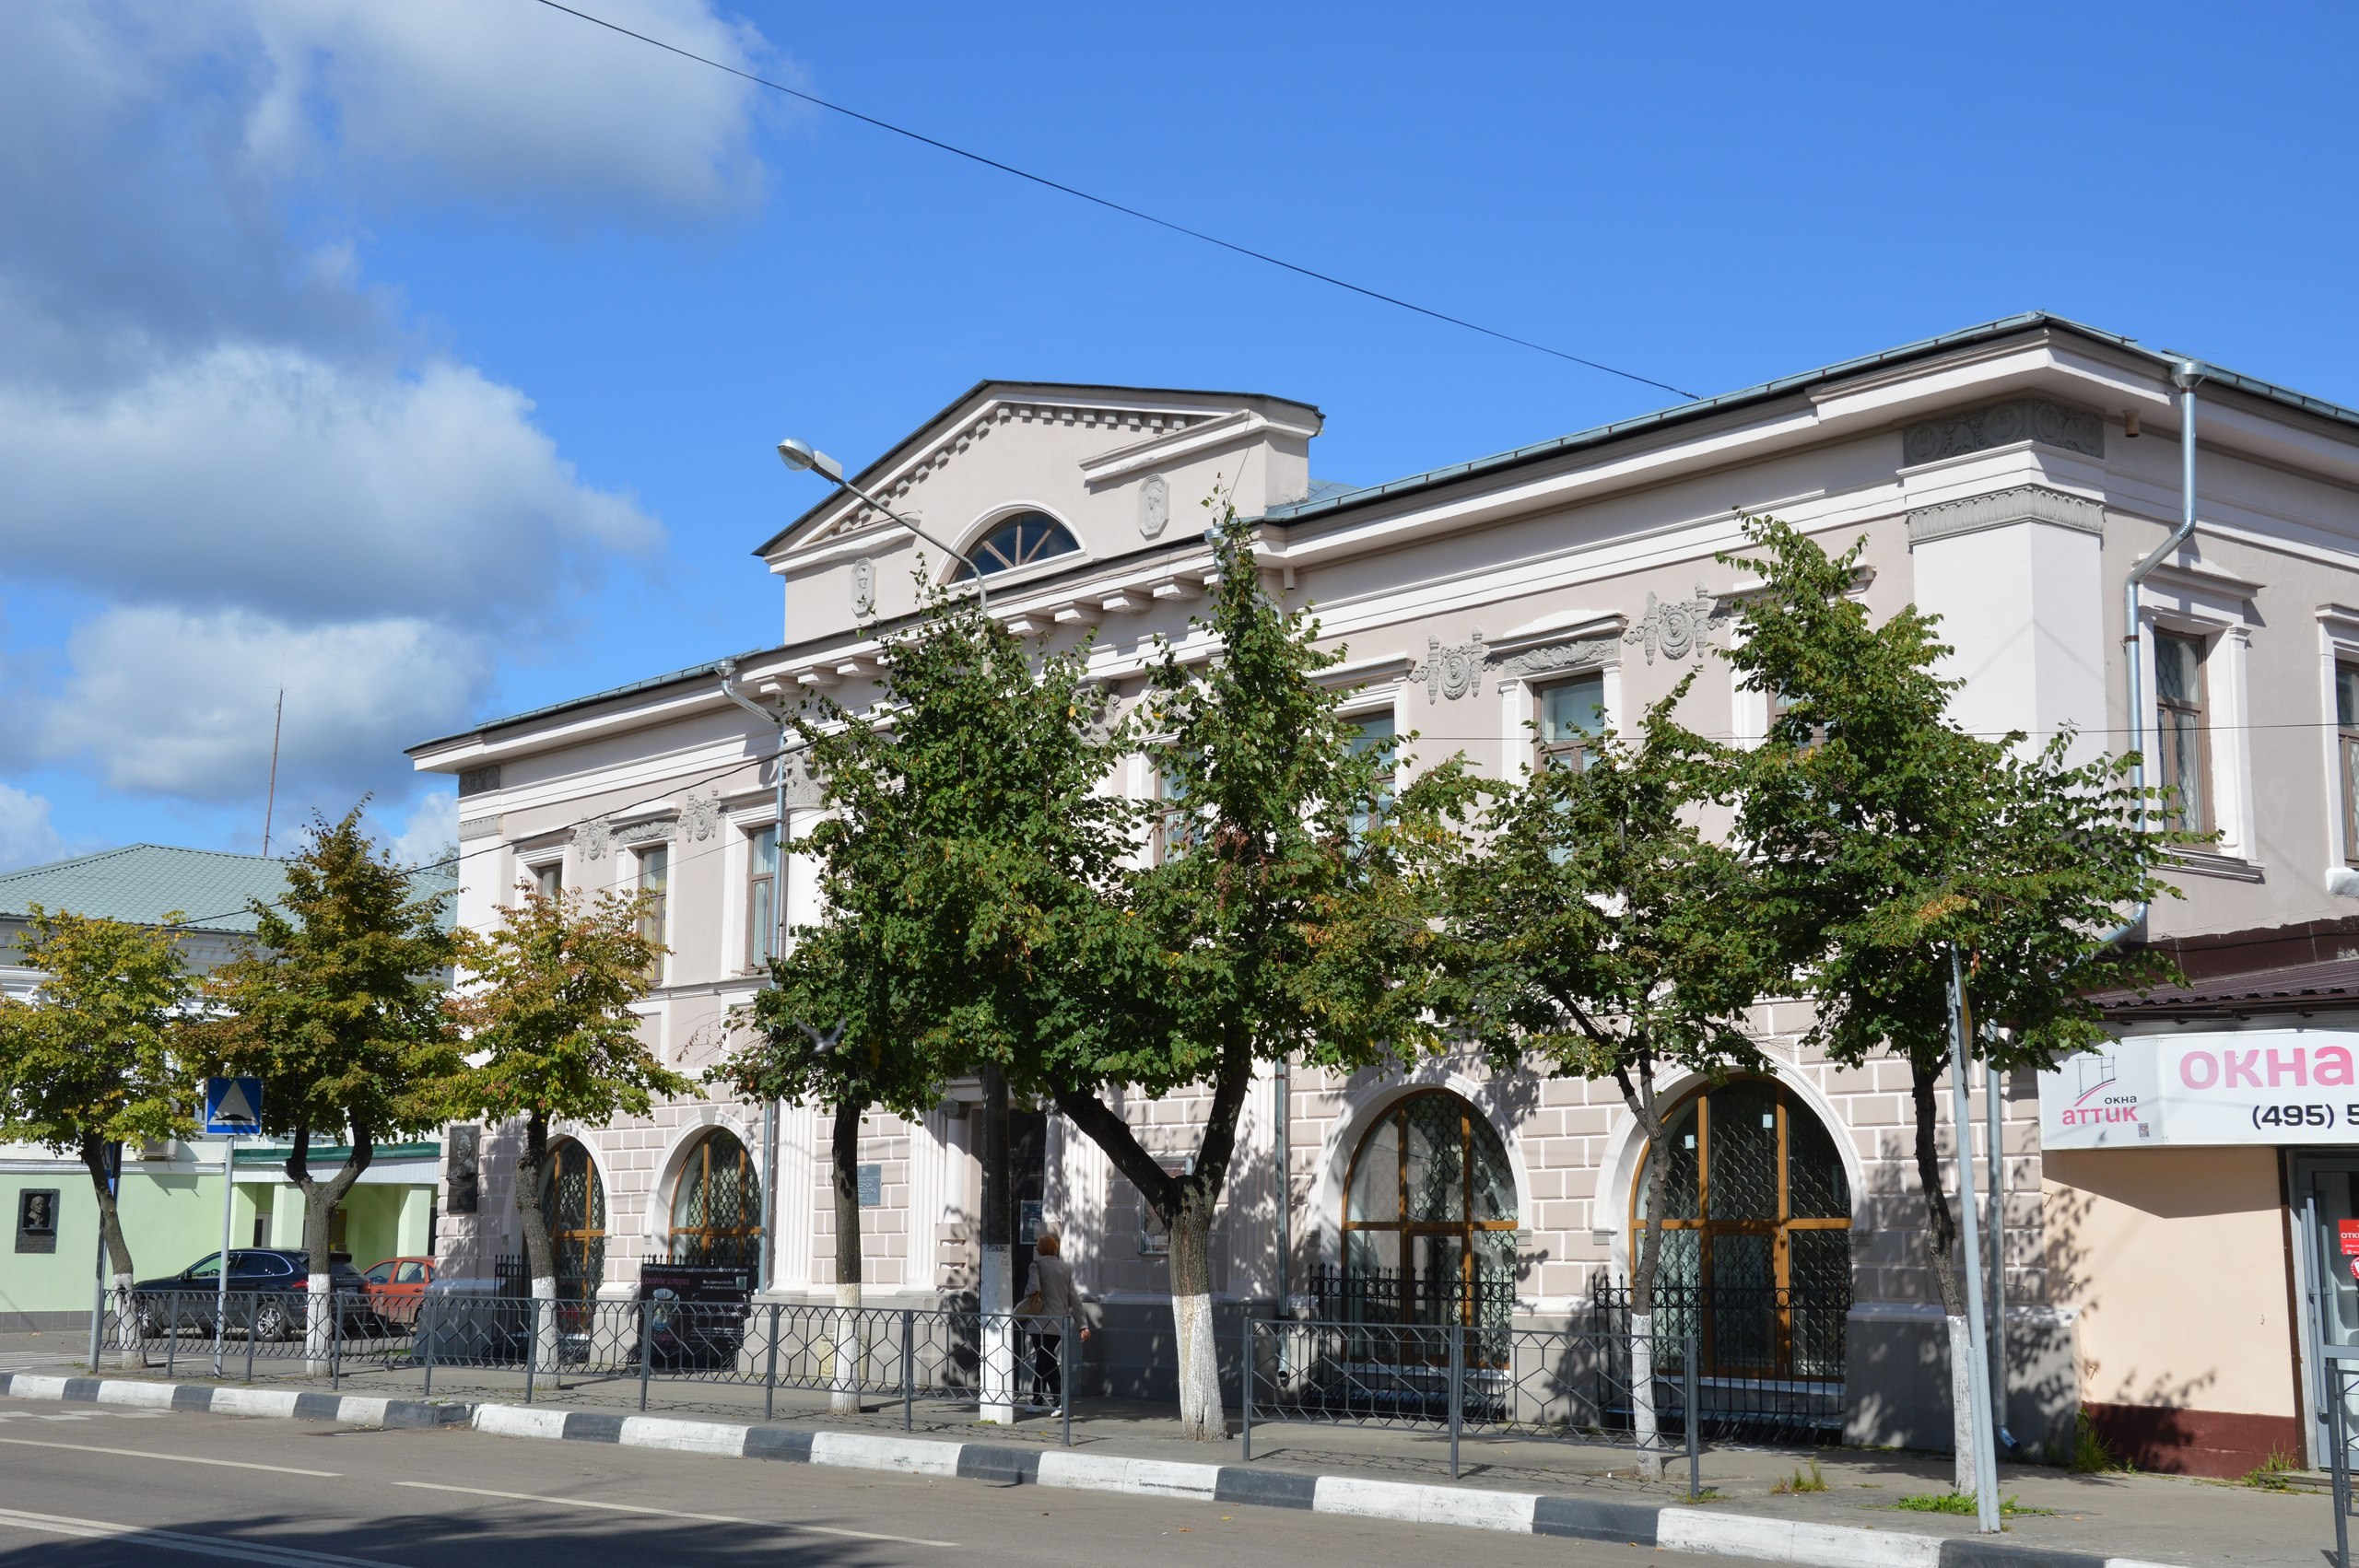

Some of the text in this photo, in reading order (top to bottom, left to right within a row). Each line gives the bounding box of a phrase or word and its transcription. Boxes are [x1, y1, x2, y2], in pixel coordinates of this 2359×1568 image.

[2179, 1046, 2354, 1090] окна
[2104, 1095, 2137, 1105] окна
[2252, 1104, 2335, 1130] (495)
